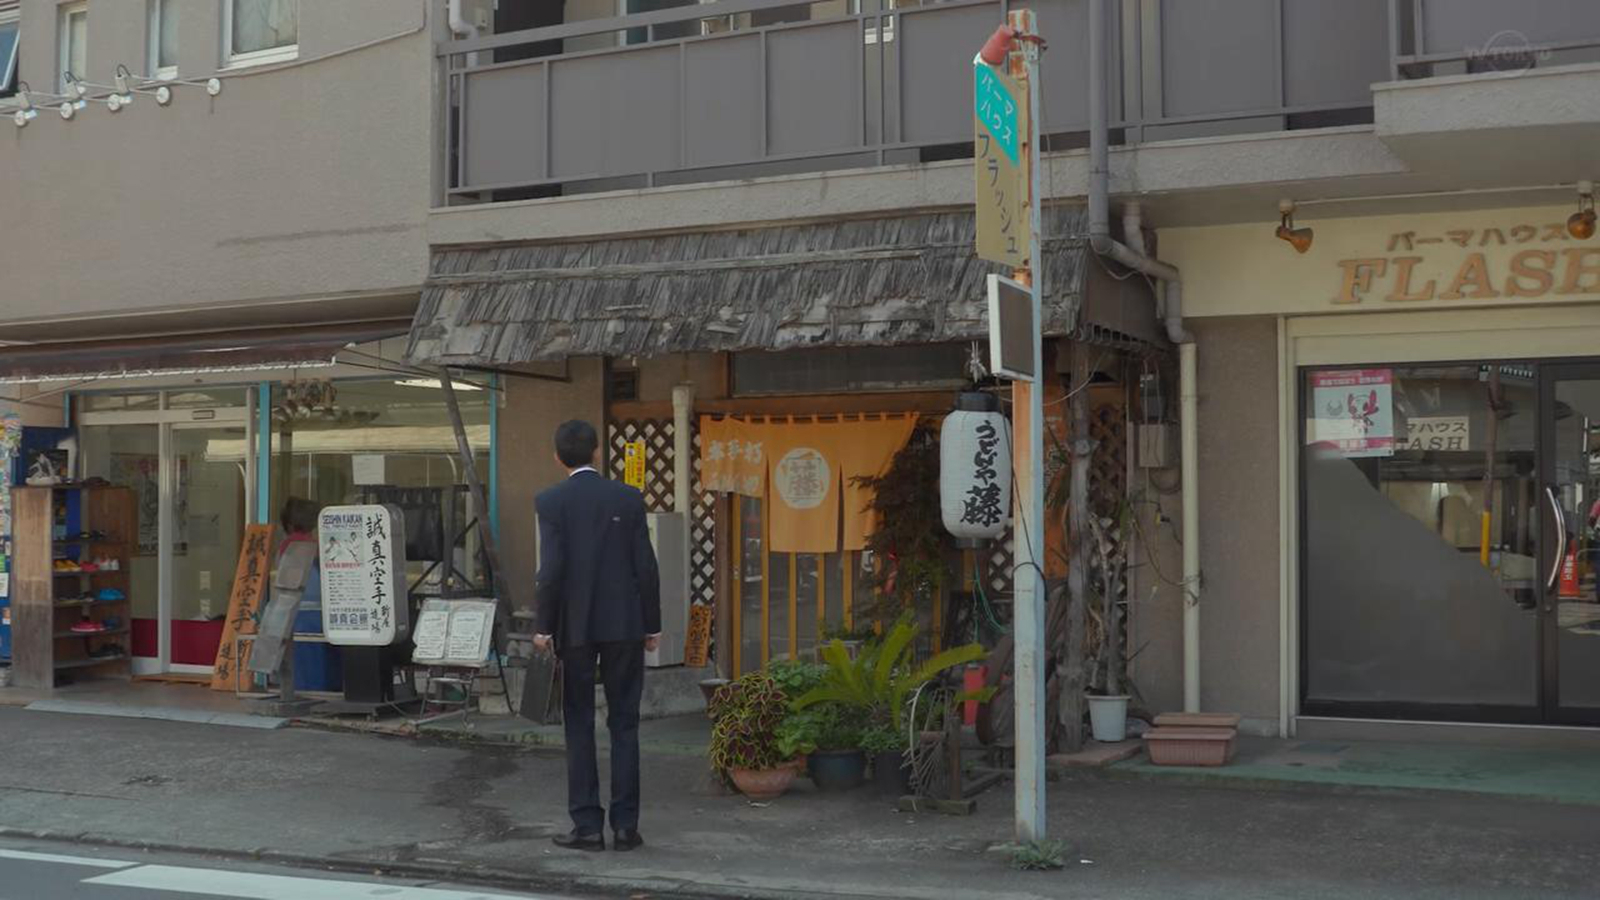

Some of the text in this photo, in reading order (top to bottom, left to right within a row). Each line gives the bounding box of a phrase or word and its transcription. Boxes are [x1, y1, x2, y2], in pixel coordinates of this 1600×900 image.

[980, 99, 1013, 146] ハウス
[978, 133, 1018, 254] フラッシュ
[1331, 247, 1600, 305] FLASH
[231, 531, 267, 631] 誠真空手
[365, 512, 386, 605] 誠真空手
